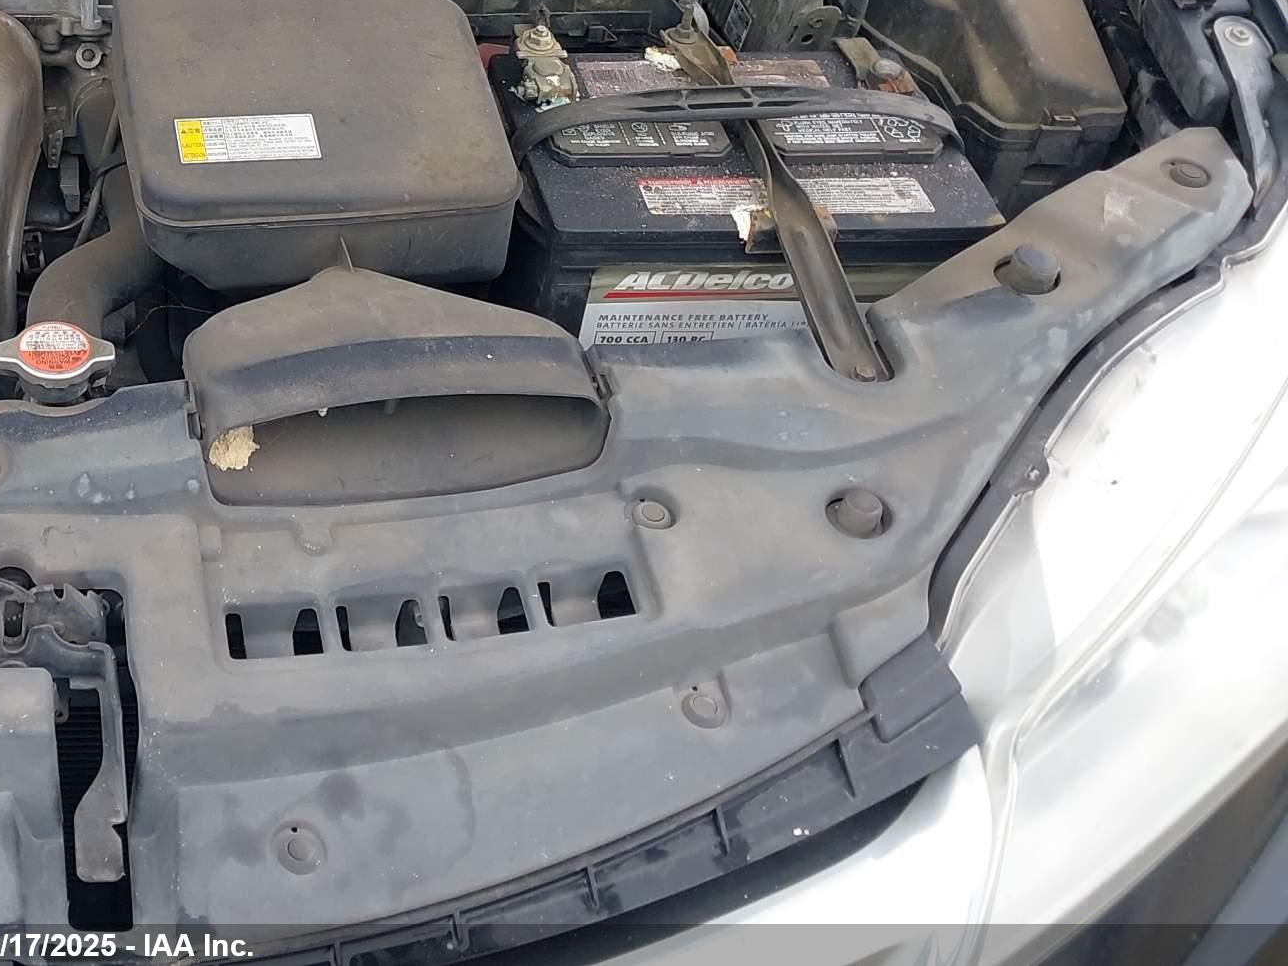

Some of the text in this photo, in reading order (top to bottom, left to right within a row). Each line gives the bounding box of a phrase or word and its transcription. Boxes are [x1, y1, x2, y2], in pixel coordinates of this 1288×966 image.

[613, 270, 795, 291] ACDelco
[598, 314, 685, 322] MAINTENANCE
[718, 314, 769, 322] BATTERY
[678, 321, 735, 329] ENTRETIEN
[599, 335, 649, 344] 700 CCA
[667, 335, 687, 344] 130
